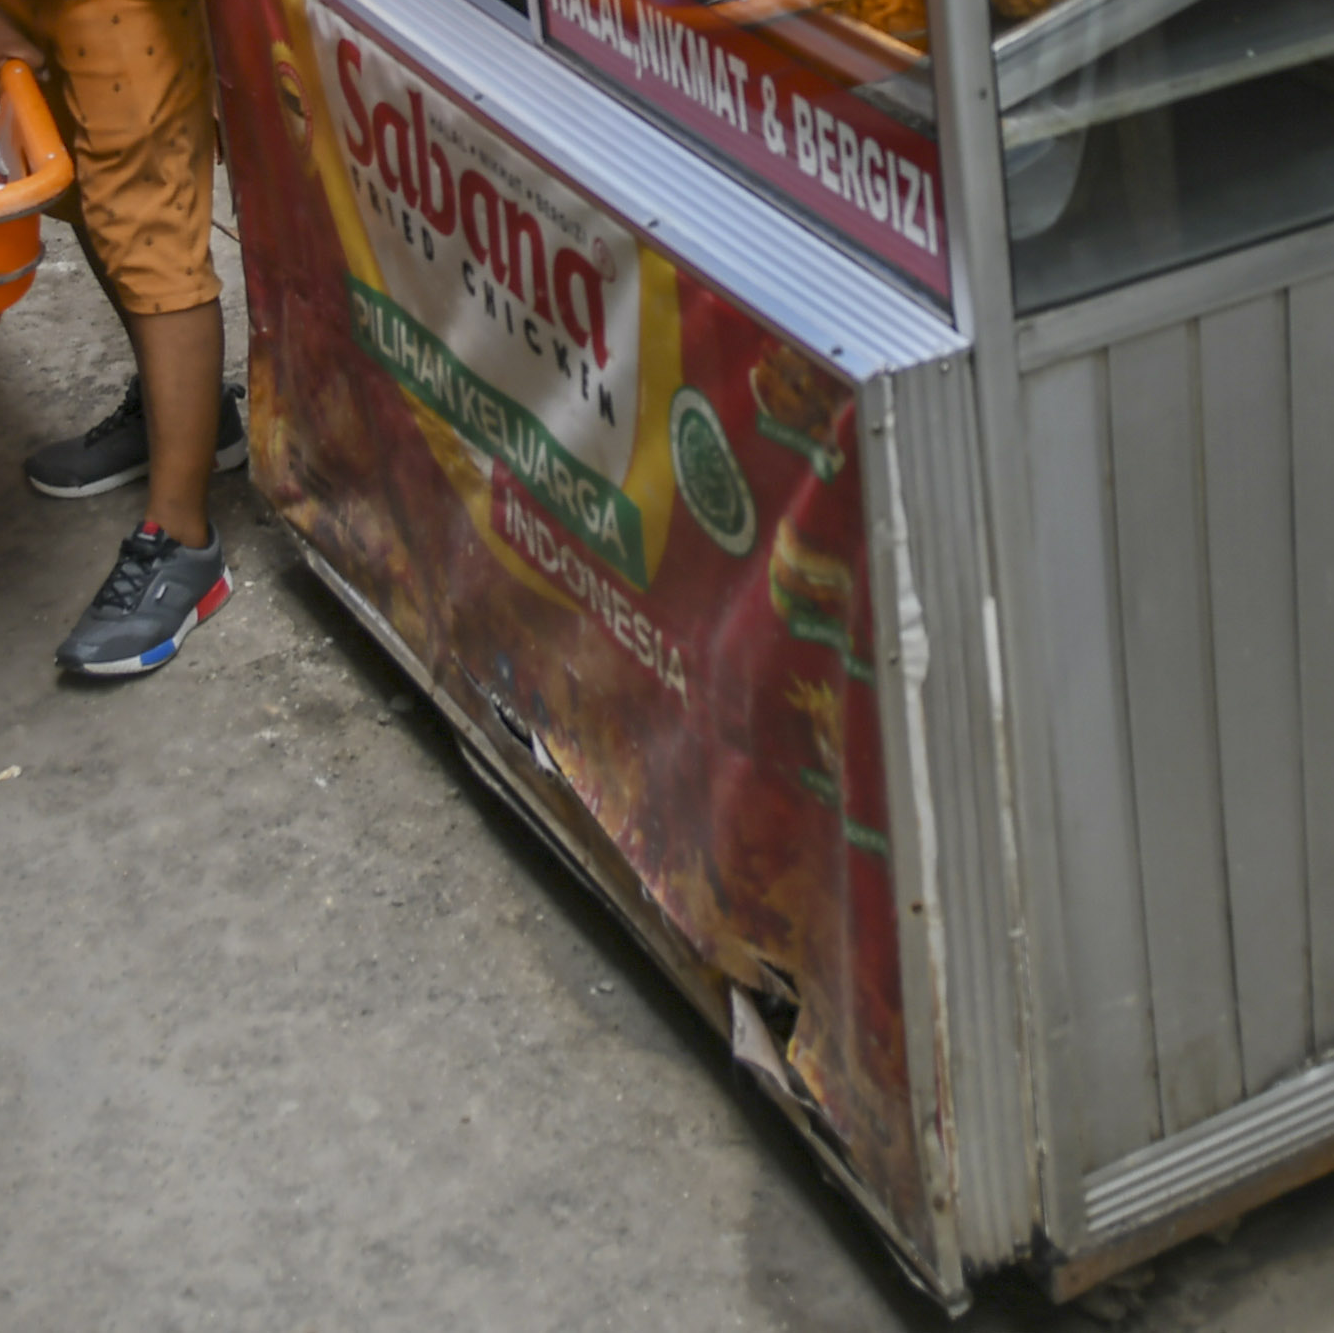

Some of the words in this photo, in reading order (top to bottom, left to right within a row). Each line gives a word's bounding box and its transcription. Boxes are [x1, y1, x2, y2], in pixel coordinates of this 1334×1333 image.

[335, 37, 611, 372] Sabana
[350, 164, 435, 262] FRIED
[460, 260, 616, 429] CHICKEN
[760, 74, 787, 158] &
[791, 92, 939, 257] BERGIZI
[351, 288, 456, 414] PILIHAN
[460, 386, 628, 561] KELUARGA
[503, 486, 690, 713] INDONESIA
